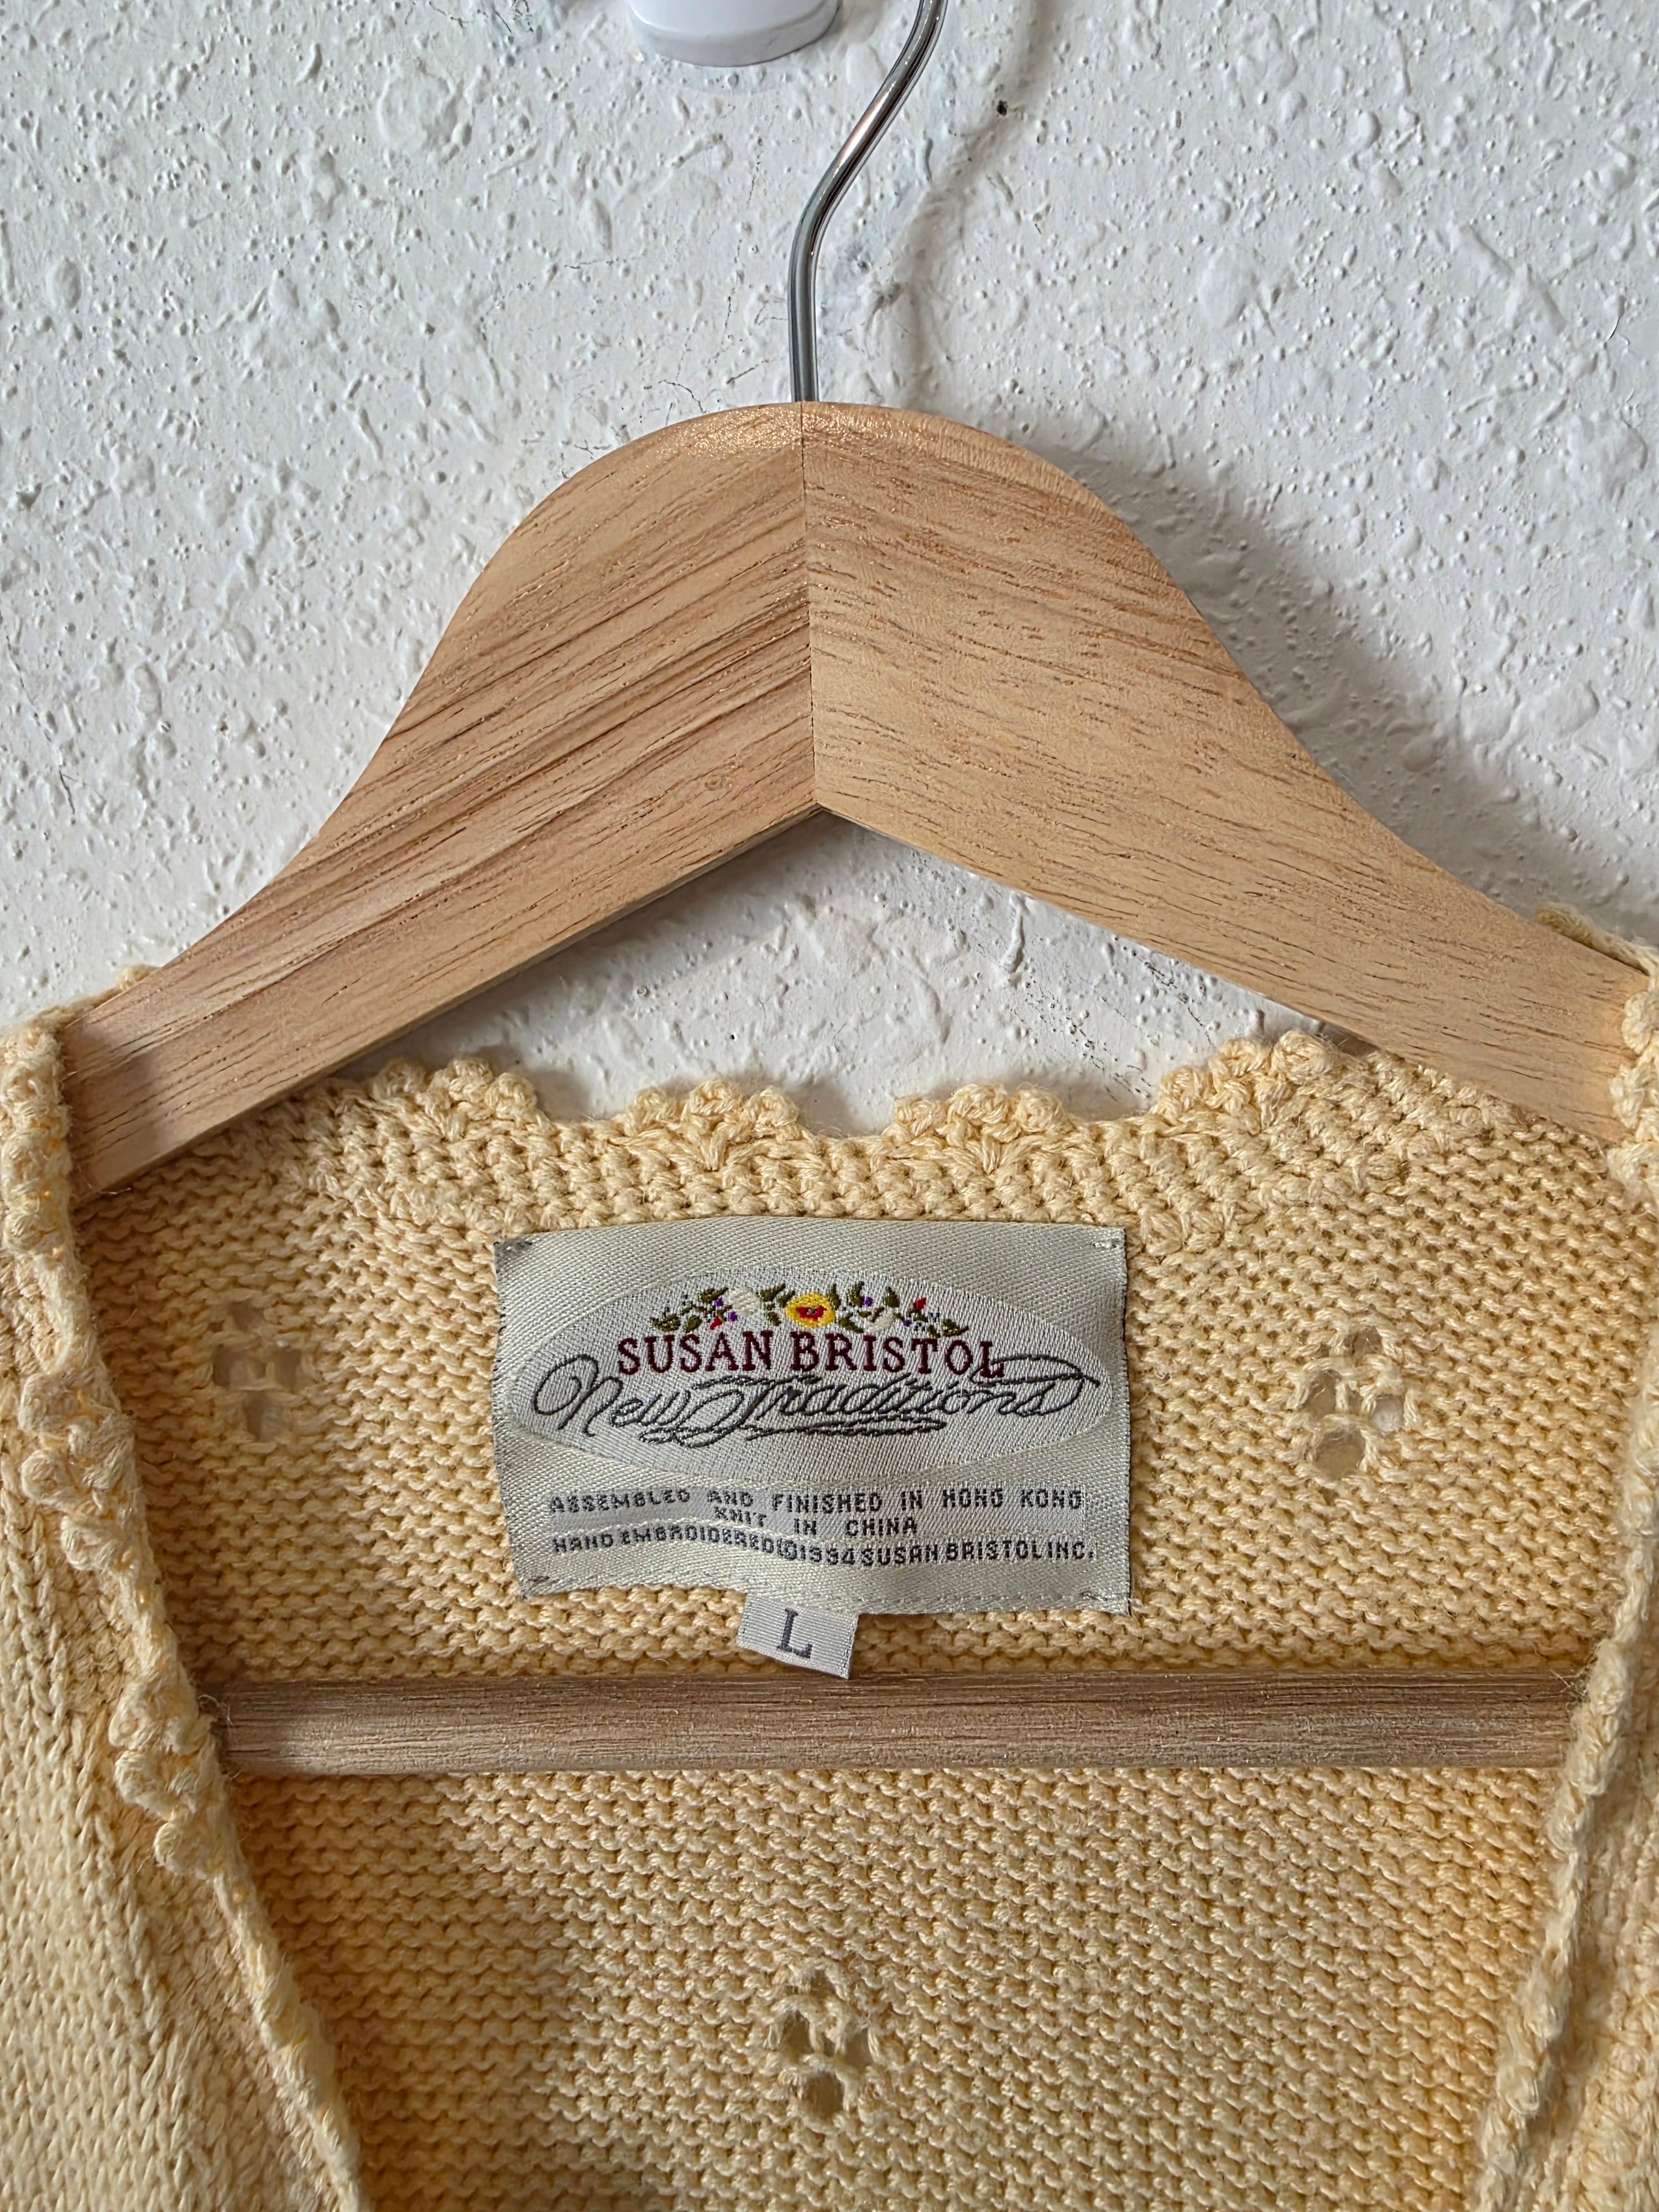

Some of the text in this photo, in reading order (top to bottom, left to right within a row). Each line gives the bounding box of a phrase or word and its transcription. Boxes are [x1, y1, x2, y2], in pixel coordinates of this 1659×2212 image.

[617, 1329, 1005, 1378] SUSAN BRISTOL
[531, 1353, 1101, 1448] New Traditions
[551, 1488, 1082, 1514] ASSEMBLED AND FINISHED IN HONG KONG
[715, 1506, 917, 1537] KNIT IN CHINA
[553, 1533, 614, 1552] HAND
[620, 1524, 774, 1553] EMBROIDERED
[861, 1543, 938, 1566] SUSAN
[946, 1541, 1042, 1561] BRISTOL
[776, 1608, 813, 1659] L
